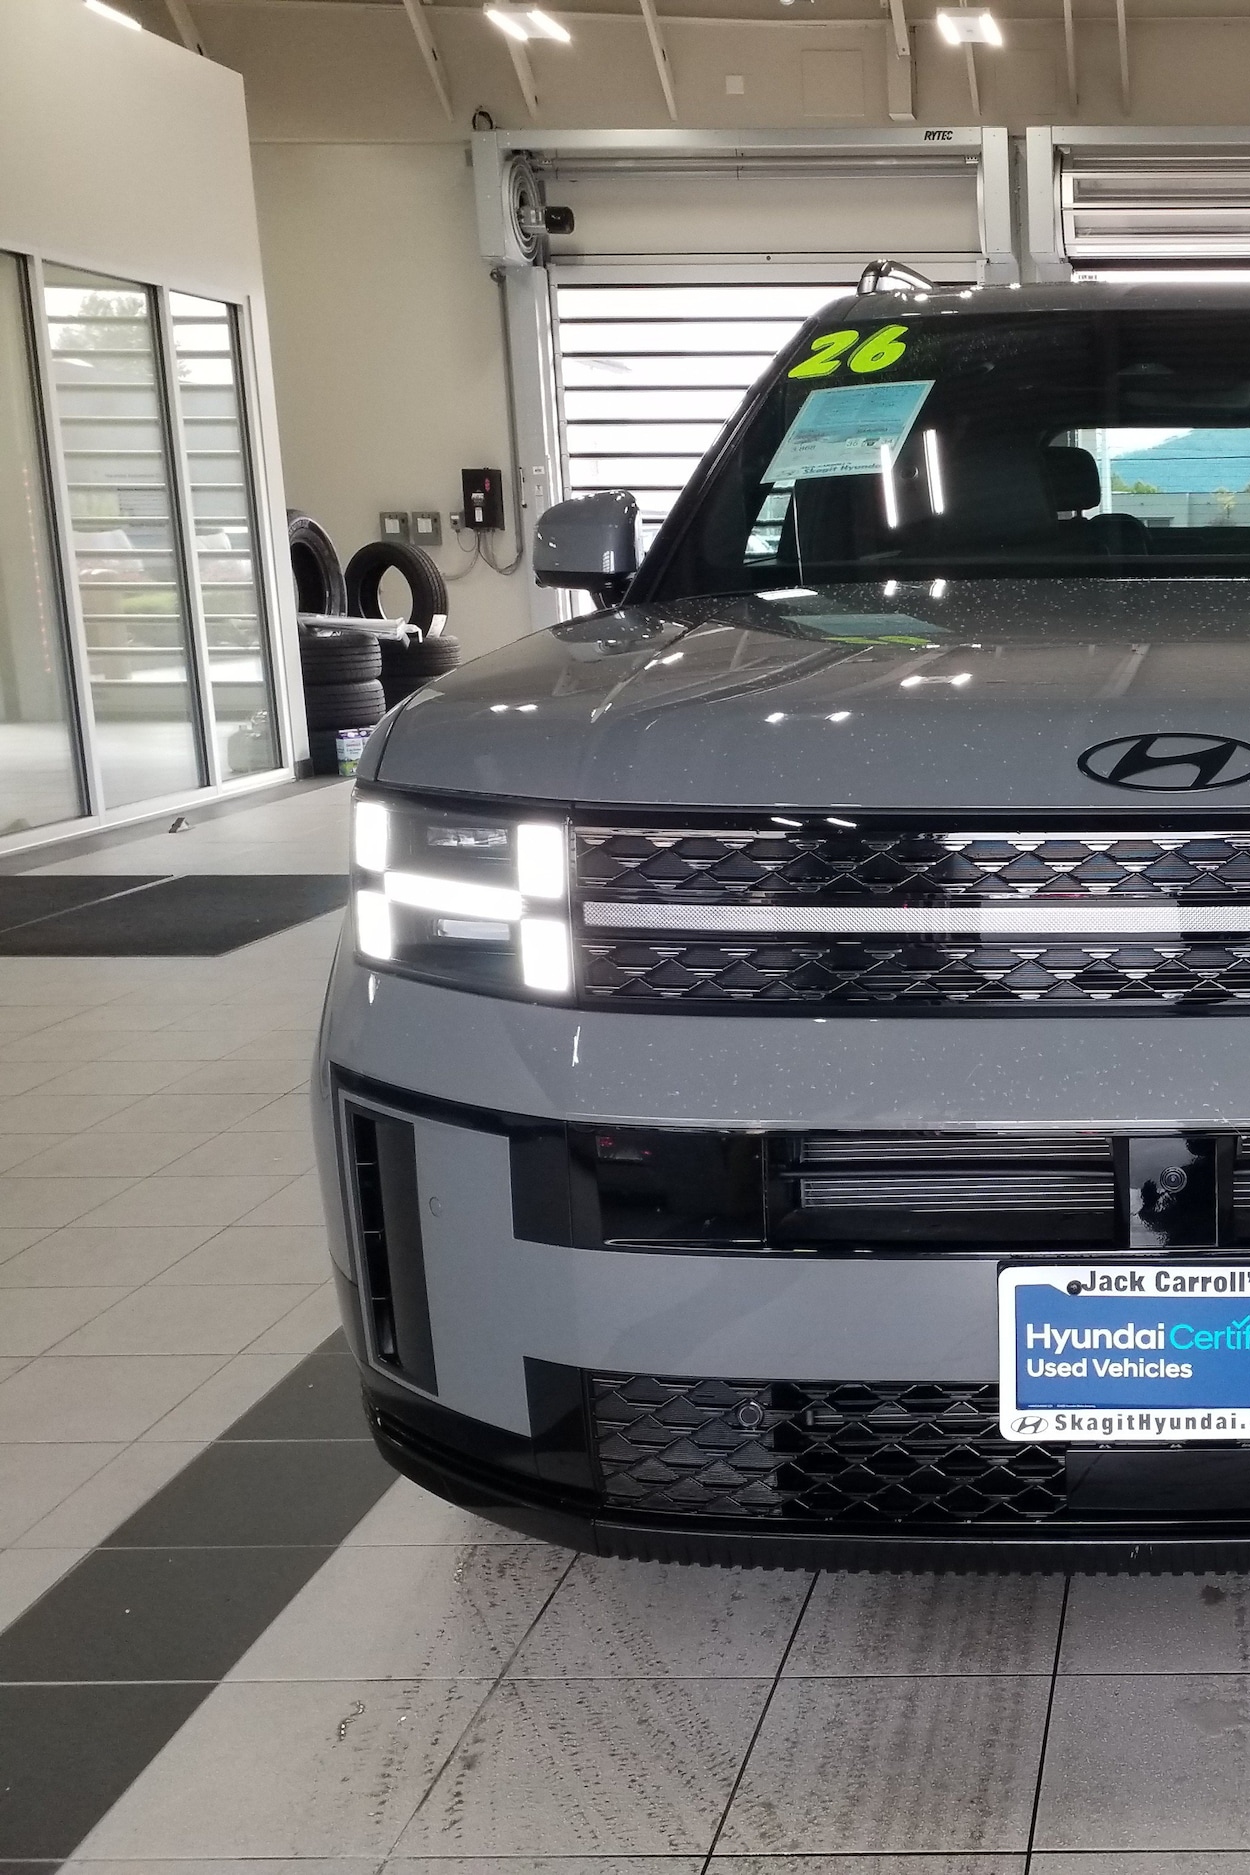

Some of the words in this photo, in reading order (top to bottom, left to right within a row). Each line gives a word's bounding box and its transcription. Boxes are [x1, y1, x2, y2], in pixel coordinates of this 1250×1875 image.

[924, 130, 953, 141] RYTEC
[787, 324, 909, 379] 26
[1080, 1270, 1145, 1292] Jack
[1026, 1322, 1166, 1354] Hyundai
[1026, 1358, 1088, 1378] Used
[1092, 1358, 1193, 1378] Vehicles
